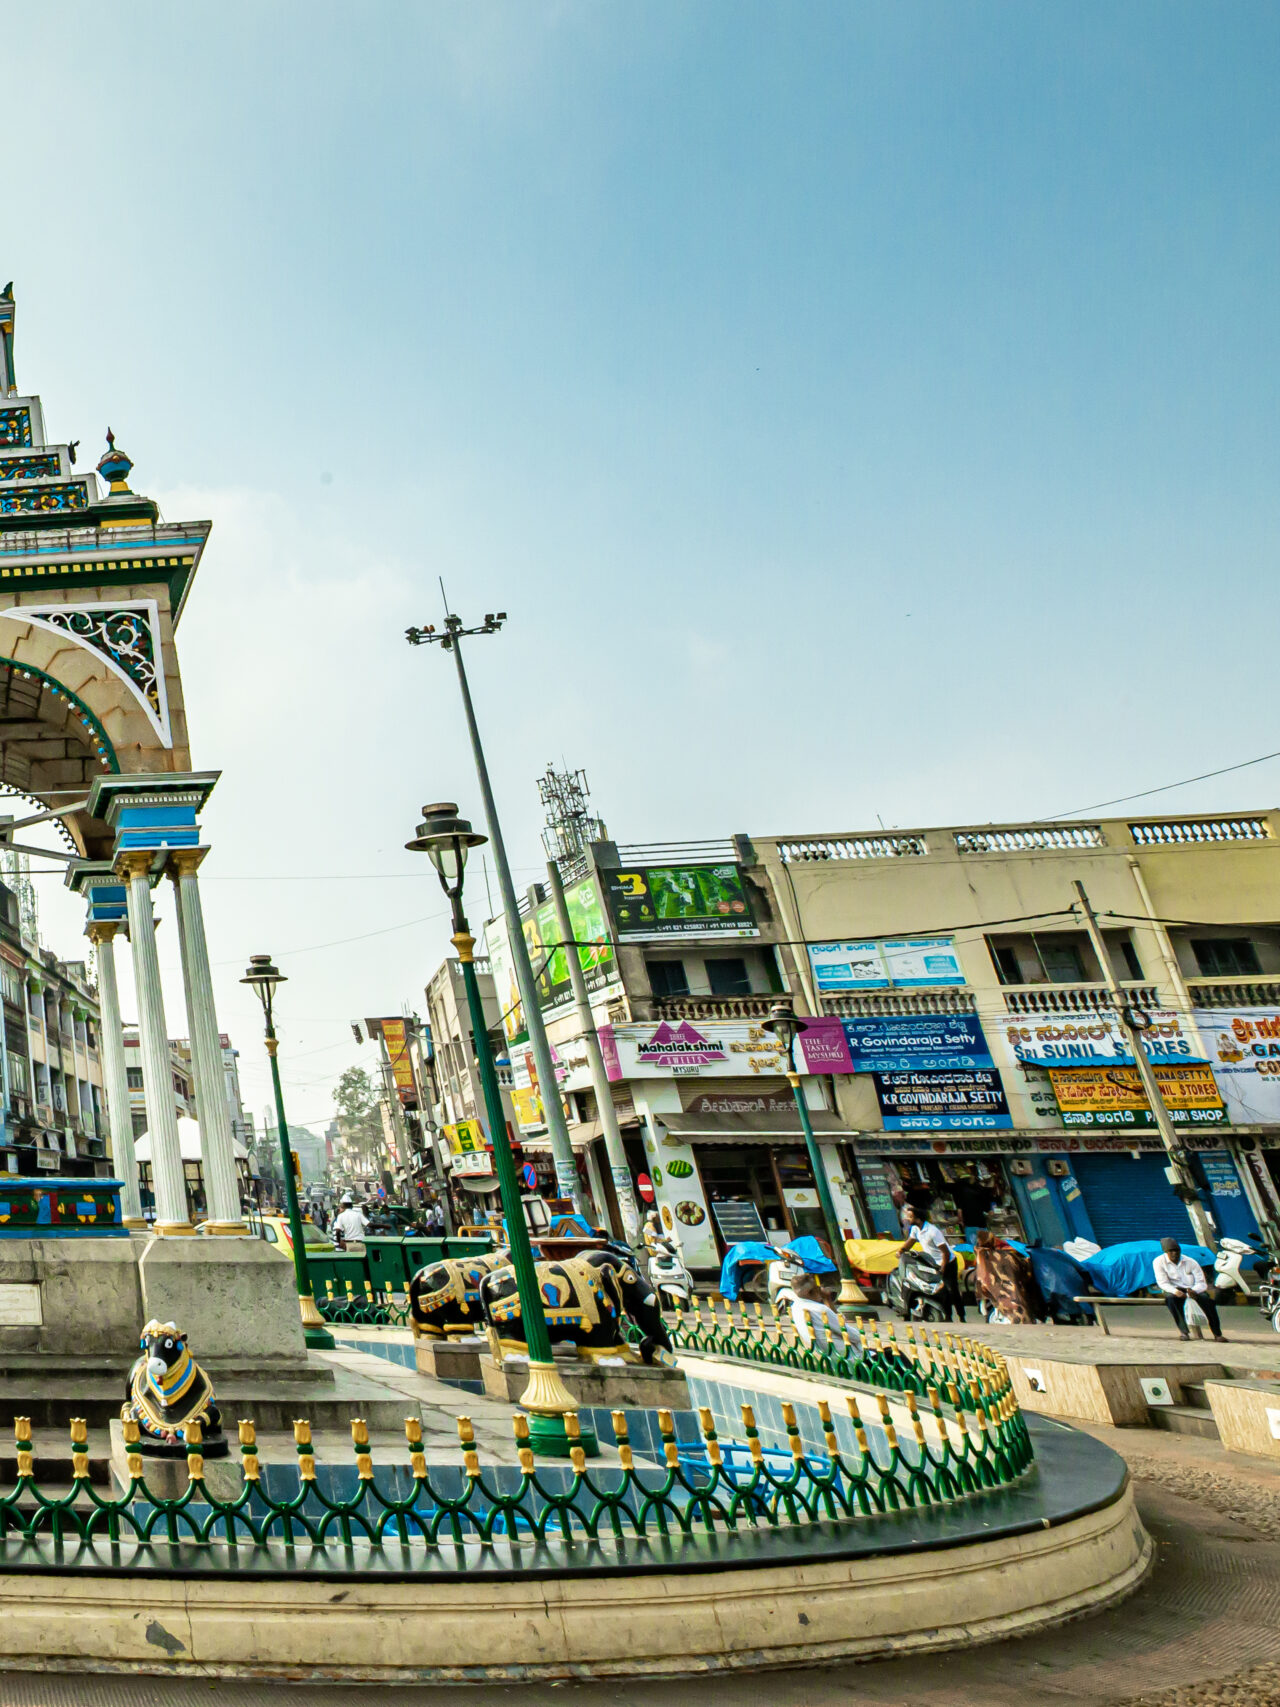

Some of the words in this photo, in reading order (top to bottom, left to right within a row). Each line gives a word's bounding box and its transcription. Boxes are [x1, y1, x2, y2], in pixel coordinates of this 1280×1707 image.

[945, 1033, 976, 1045] Setty
[637, 1040, 723, 1053] Mahalakshmi
[806, 1044, 831, 1052] TASTE
[1043, 1043, 1104, 1059] SUNIL
[666, 1056, 703, 1065] SWEETS
[808, 1051, 844, 1060] MYSURU
[672, 1066, 700, 1074] MYSURU
[1178, 1070, 1211, 1081] SETTY
[1180, 1082, 1217, 1096] STORES
[882, 1092, 968, 1105] K.R.GOVINDARAJA
[970, 1091, 1003, 1103] SETTY
[1146, 1110, 1188, 1122] PSARI
[1192, 1109, 1223, 1121] SHOP
[948, 1140, 997, 1151] PANSARI
[999, 1139, 1032, 1151] SHOP
[1189, 1137, 1220, 1149] SHOP
